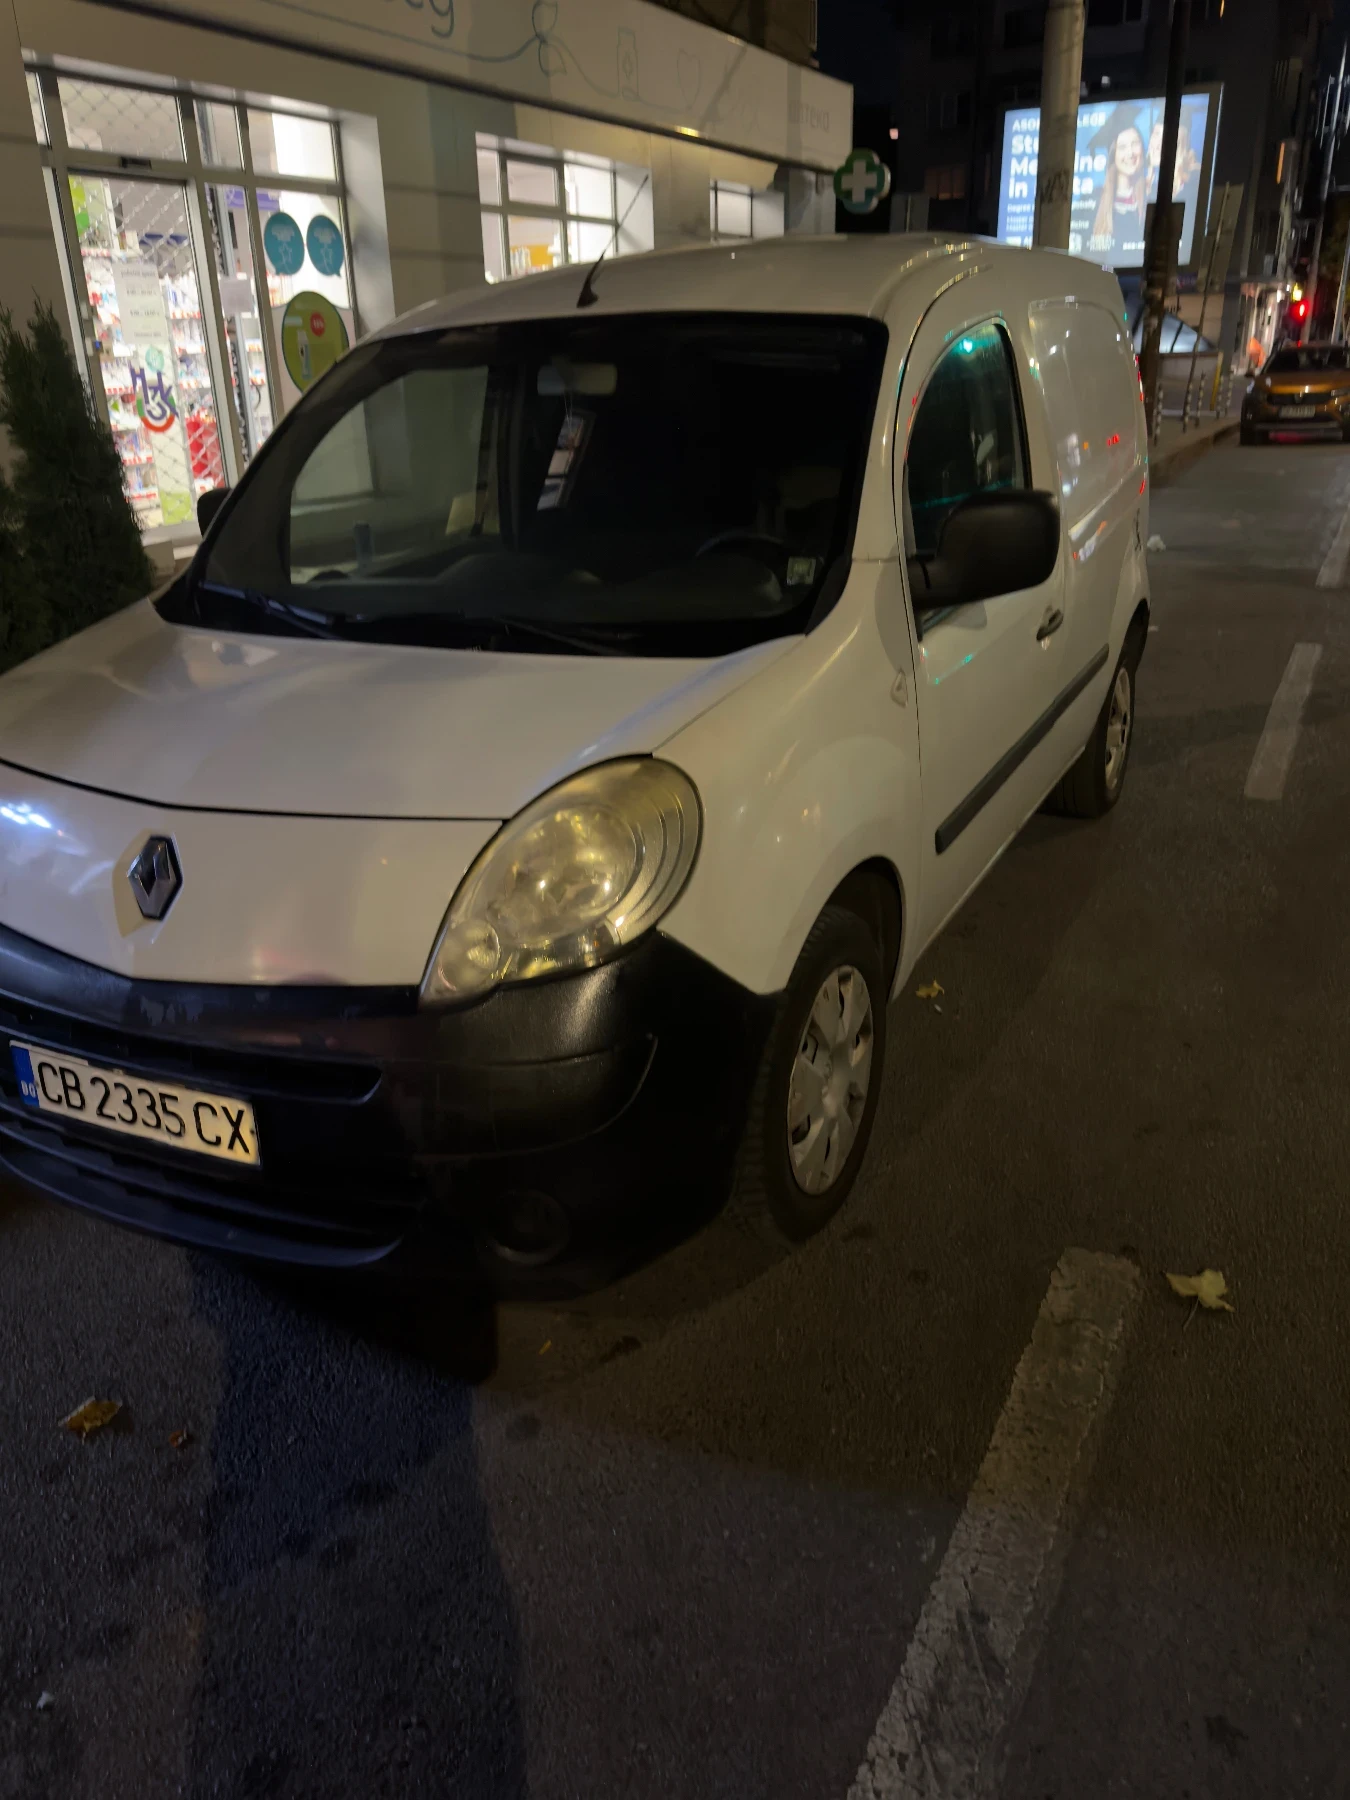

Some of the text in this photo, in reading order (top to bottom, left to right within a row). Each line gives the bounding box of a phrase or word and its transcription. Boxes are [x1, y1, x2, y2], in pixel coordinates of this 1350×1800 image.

[1010, 151, 1107, 177] Meine
[37, 1061, 251, 1154] CB 2335 CX
